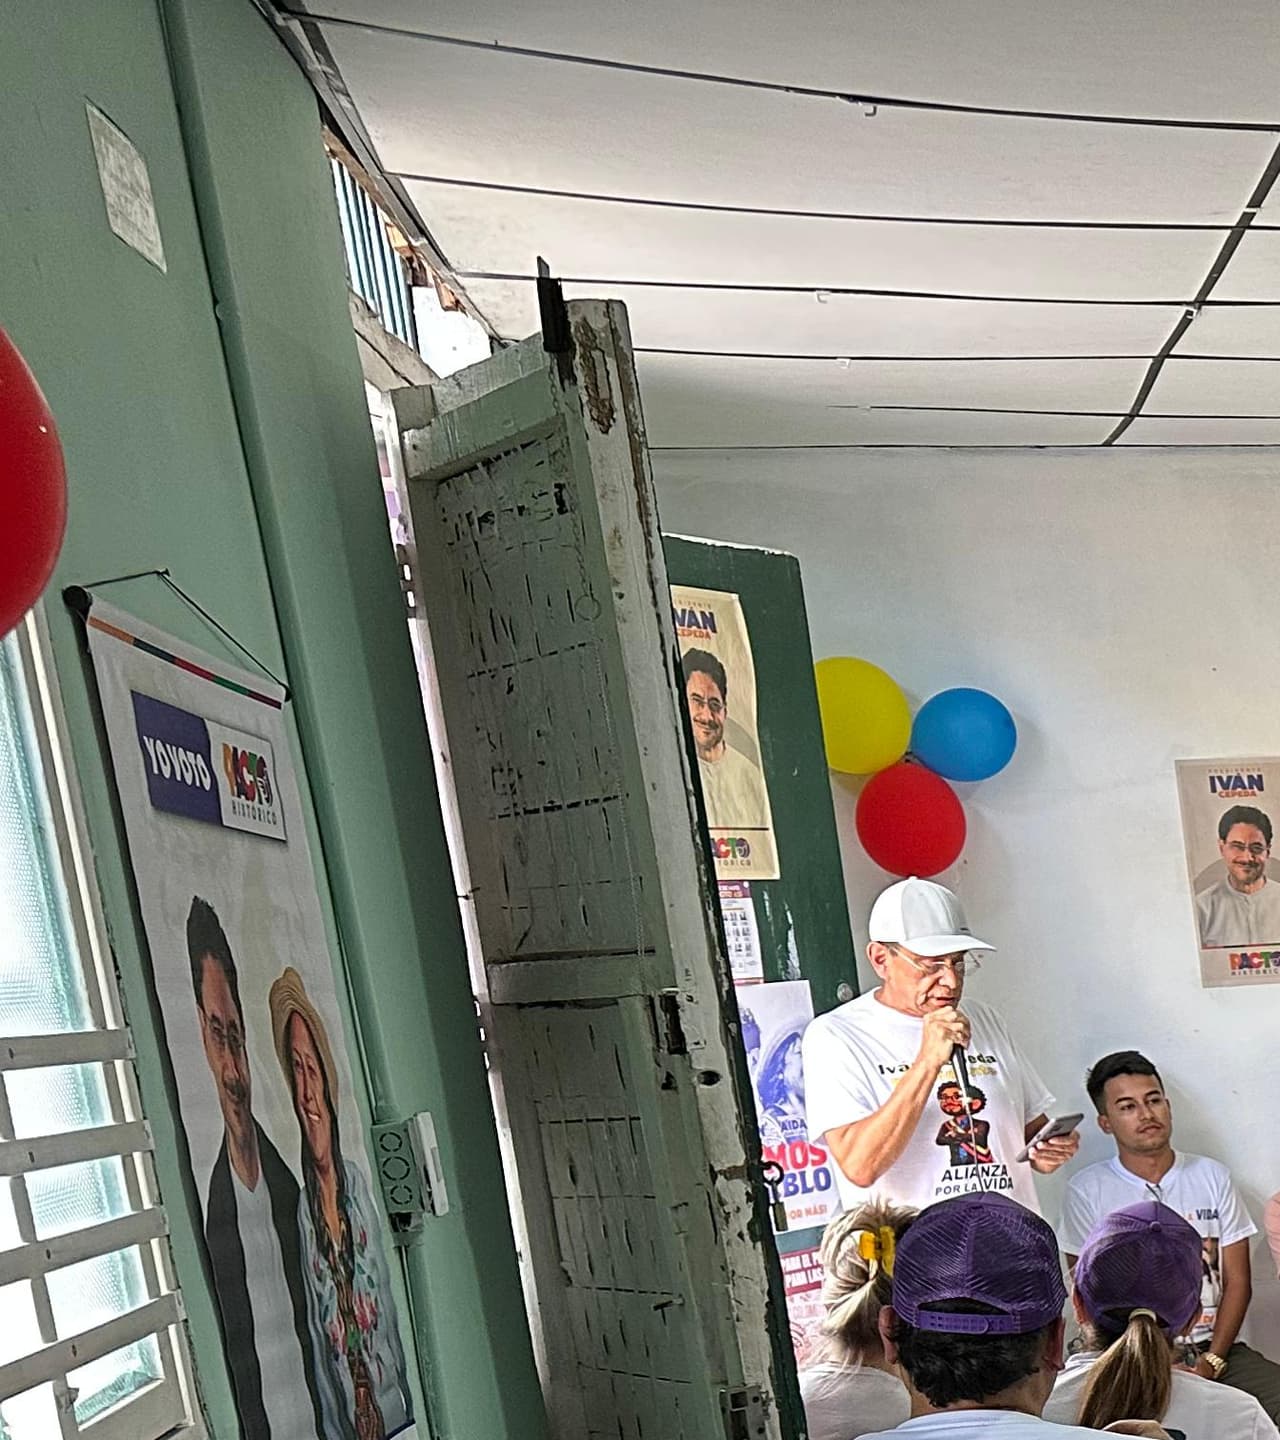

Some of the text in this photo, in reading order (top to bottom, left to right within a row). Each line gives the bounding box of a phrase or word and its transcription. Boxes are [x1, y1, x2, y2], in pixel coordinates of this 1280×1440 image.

[222, 742, 273, 808] PACTO
[1218, 790, 1257, 798] CEPEDA
[781, 1118, 807, 1132] AIDA
[941, 1164, 1008, 1182] ALIANZA
[935, 1178, 1014, 1196] POR LA VIDA
[1196, 1209, 1219, 1220] VIDA
